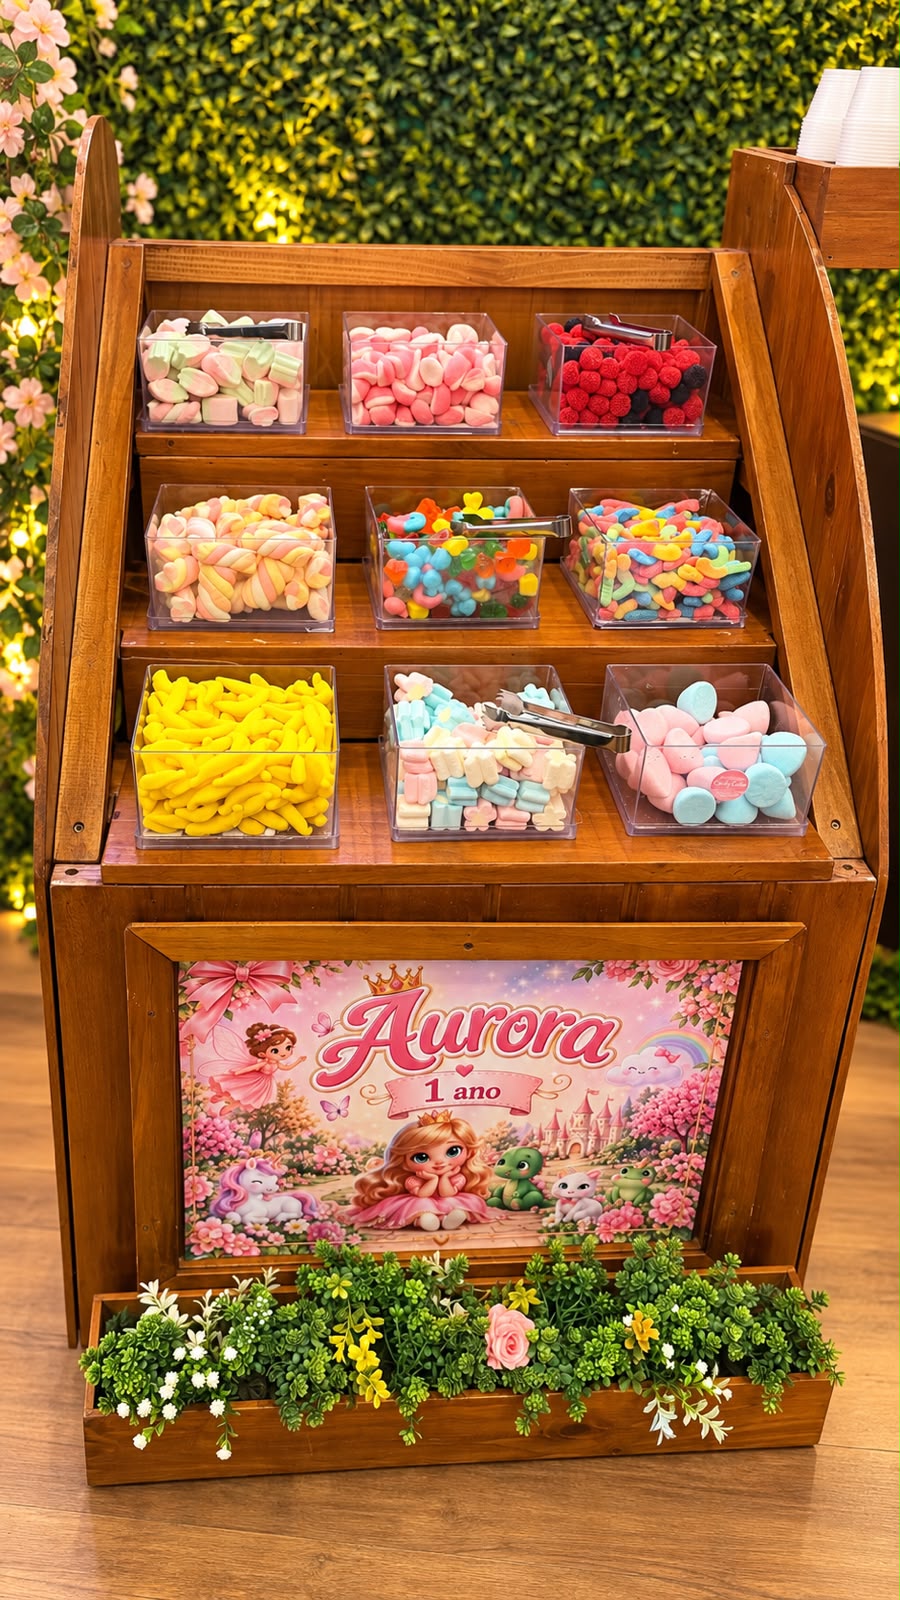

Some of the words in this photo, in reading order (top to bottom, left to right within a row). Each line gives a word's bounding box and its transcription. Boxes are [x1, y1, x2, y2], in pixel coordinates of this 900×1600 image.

[313, 986, 618, 1090] Aurora
[424, 1077, 445, 1103] 1
[453, 1085, 501, 1101] ano
